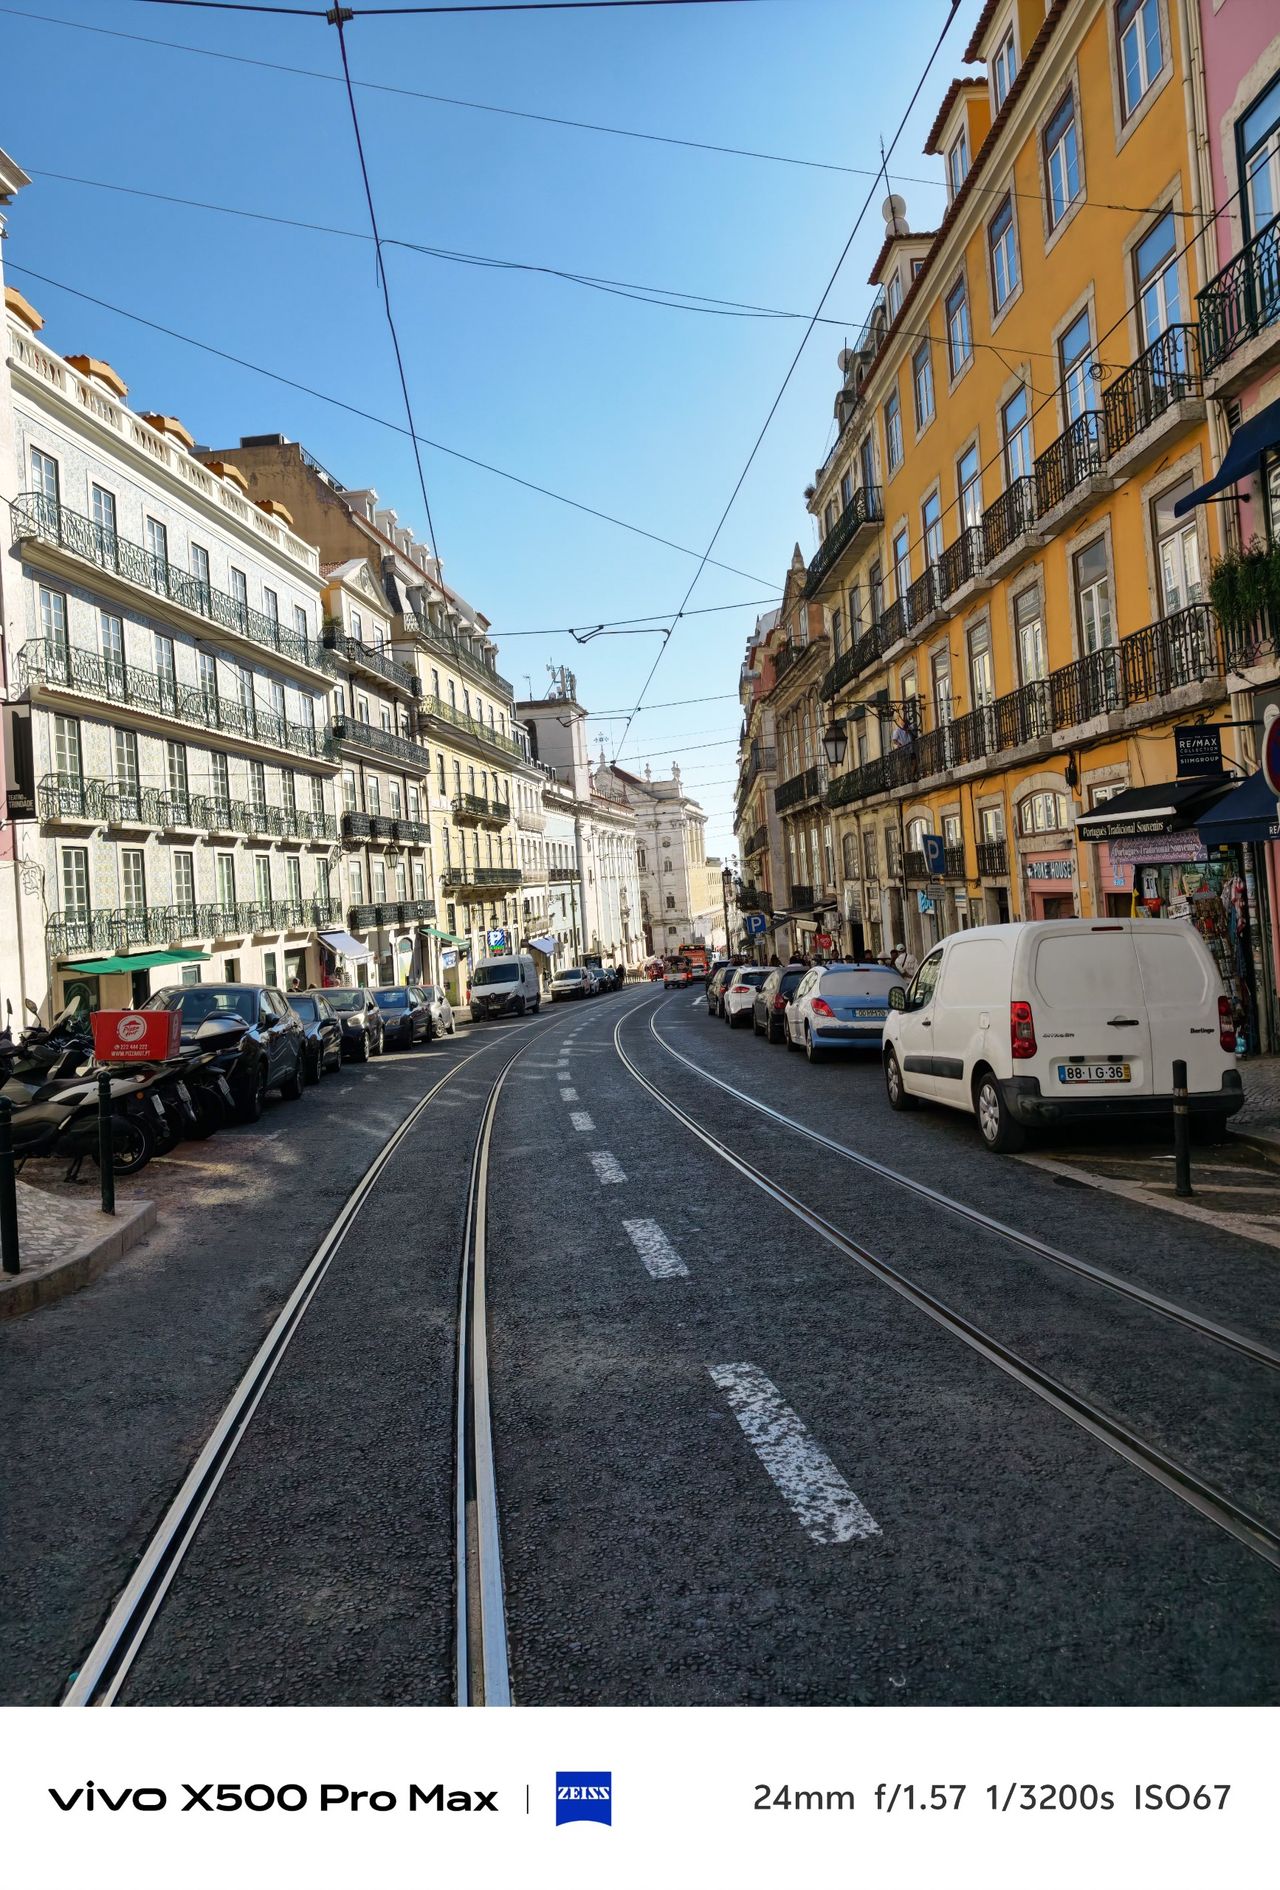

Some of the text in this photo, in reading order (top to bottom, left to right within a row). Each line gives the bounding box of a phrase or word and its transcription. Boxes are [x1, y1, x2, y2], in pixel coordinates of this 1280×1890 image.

[1180, 738, 1217, 748] RE/MAX
[1136, 820, 1164, 833] Souvenirs
[928, 840, 940, 870] P
[1051, 861, 1072, 878] HOUSE
[751, 917, 762, 932] P
[489, 931, 502, 946] P
